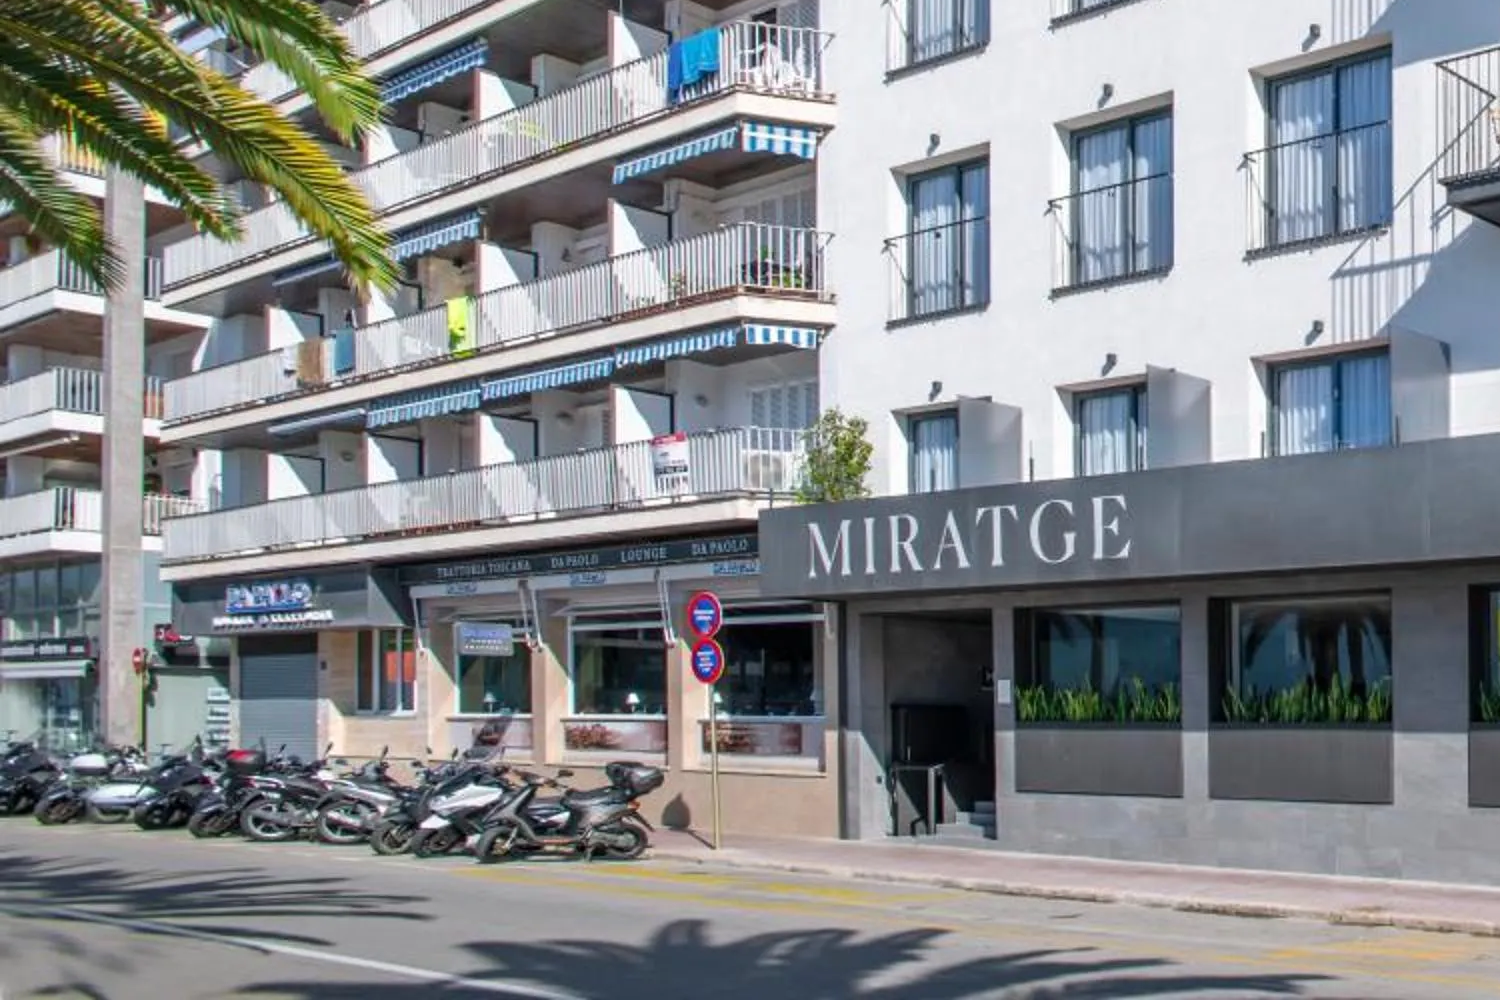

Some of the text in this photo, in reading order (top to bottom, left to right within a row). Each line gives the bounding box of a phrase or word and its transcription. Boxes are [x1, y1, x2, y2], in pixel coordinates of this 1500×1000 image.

[807, 494, 1132, 578] MIRATGE
[620, 547, 668, 563] LOUNGE
[692, 538, 749, 556] DA PAOLO
